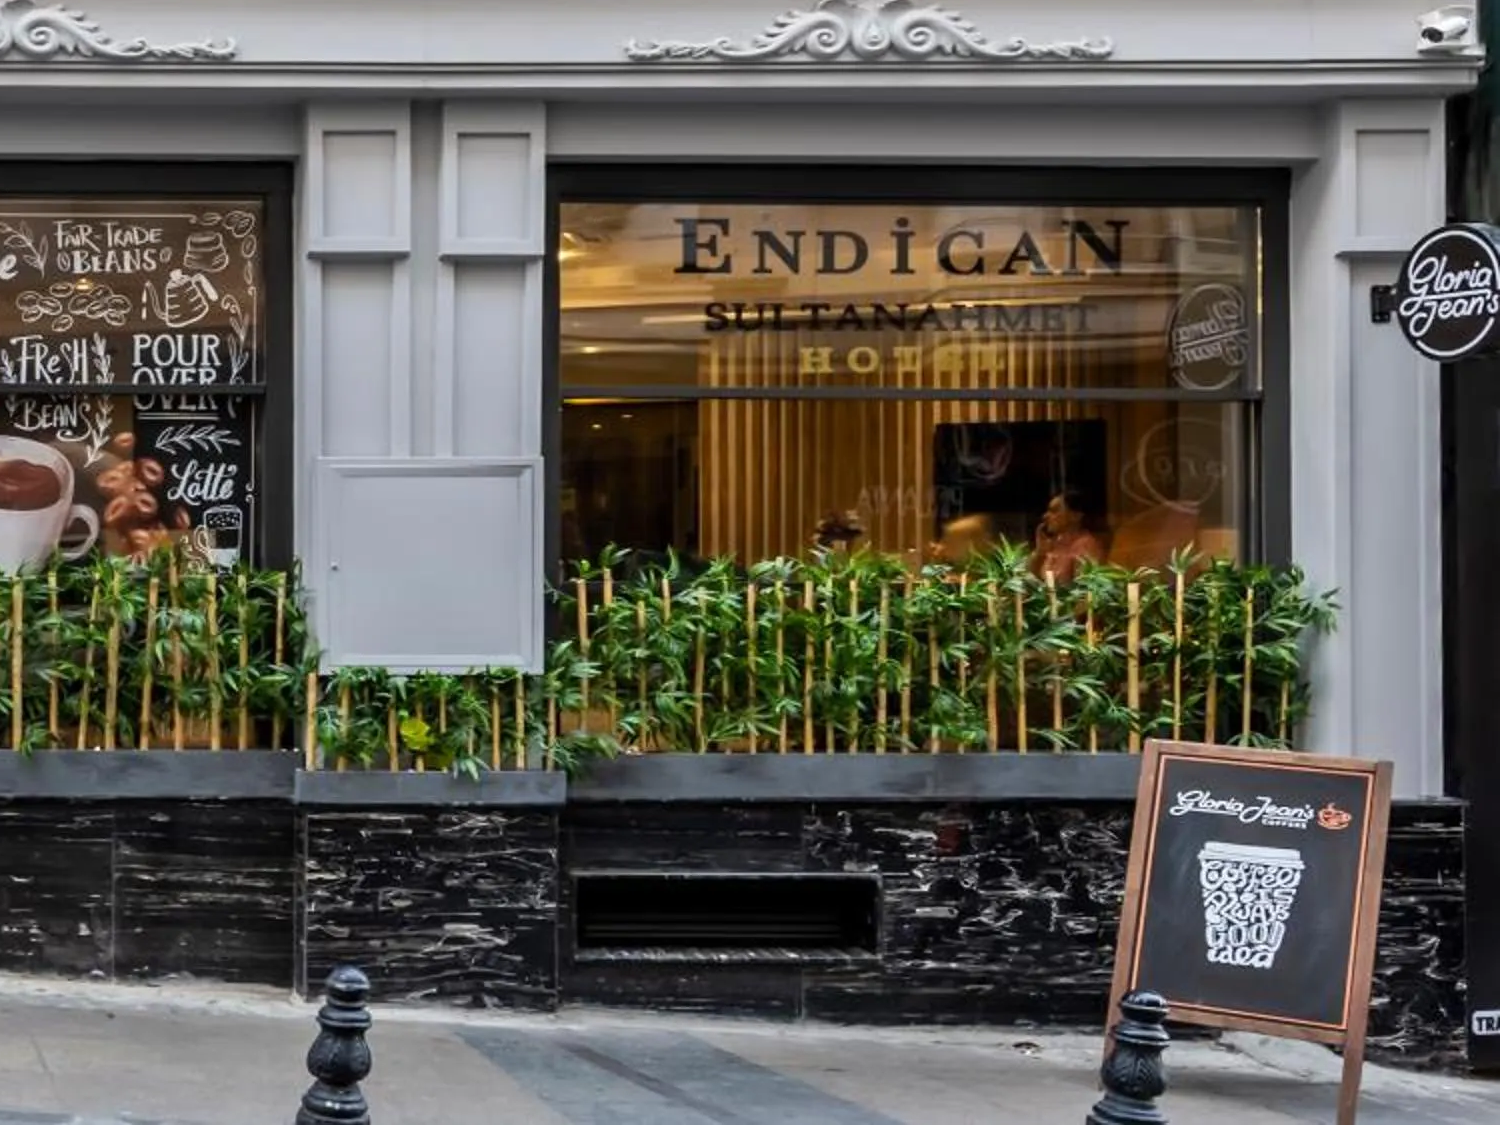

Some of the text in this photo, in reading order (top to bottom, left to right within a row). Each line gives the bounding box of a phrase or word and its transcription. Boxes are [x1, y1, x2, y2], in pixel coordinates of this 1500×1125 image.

[72, 248, 157, 274] BEANS
[1400, 255, 1492, 313] Gloria
[705, 302, 1098, 332] SULTANAHMET
[1410, 294, 1499, 337] Jean's
[132, 334, 222, 366] POUR
[132, 367, 218, 411] OVER
[14, 398, 93, 441] BEANS
[167, 459, 238, 506] Latte
[1169, 790, 1315, 823] Gloria Jean's
